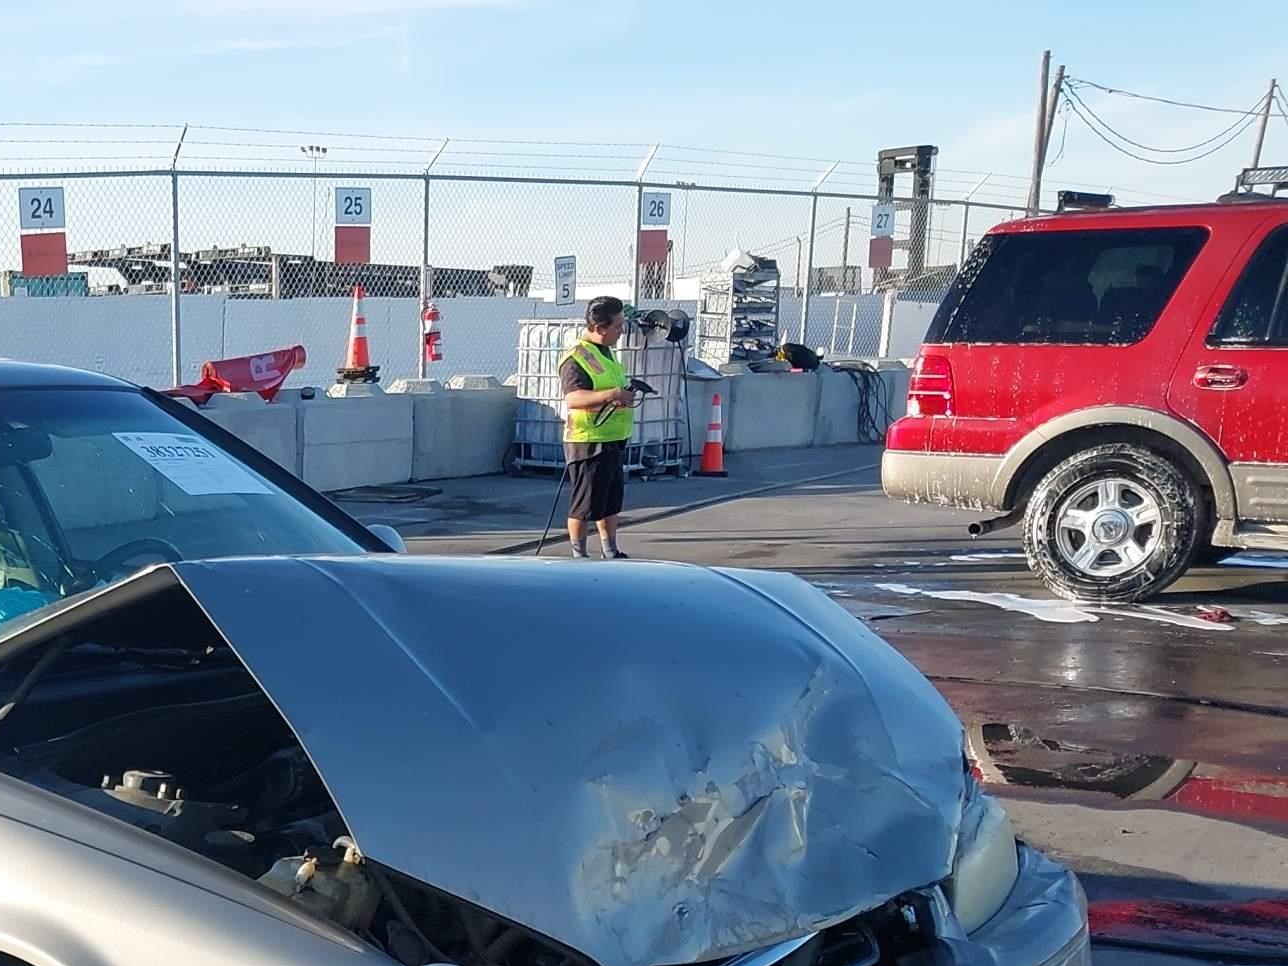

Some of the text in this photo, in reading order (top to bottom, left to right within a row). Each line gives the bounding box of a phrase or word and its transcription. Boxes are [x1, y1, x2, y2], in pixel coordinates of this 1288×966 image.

[30, 197, 55, 219] 24
[344, 196, 363, 215] 25
[649, 200, 664, 217] 26
[876, 213, 890, 229] 27
[562, 283, 570, 298] 5
[140, 445, 217, 459] 38327251
